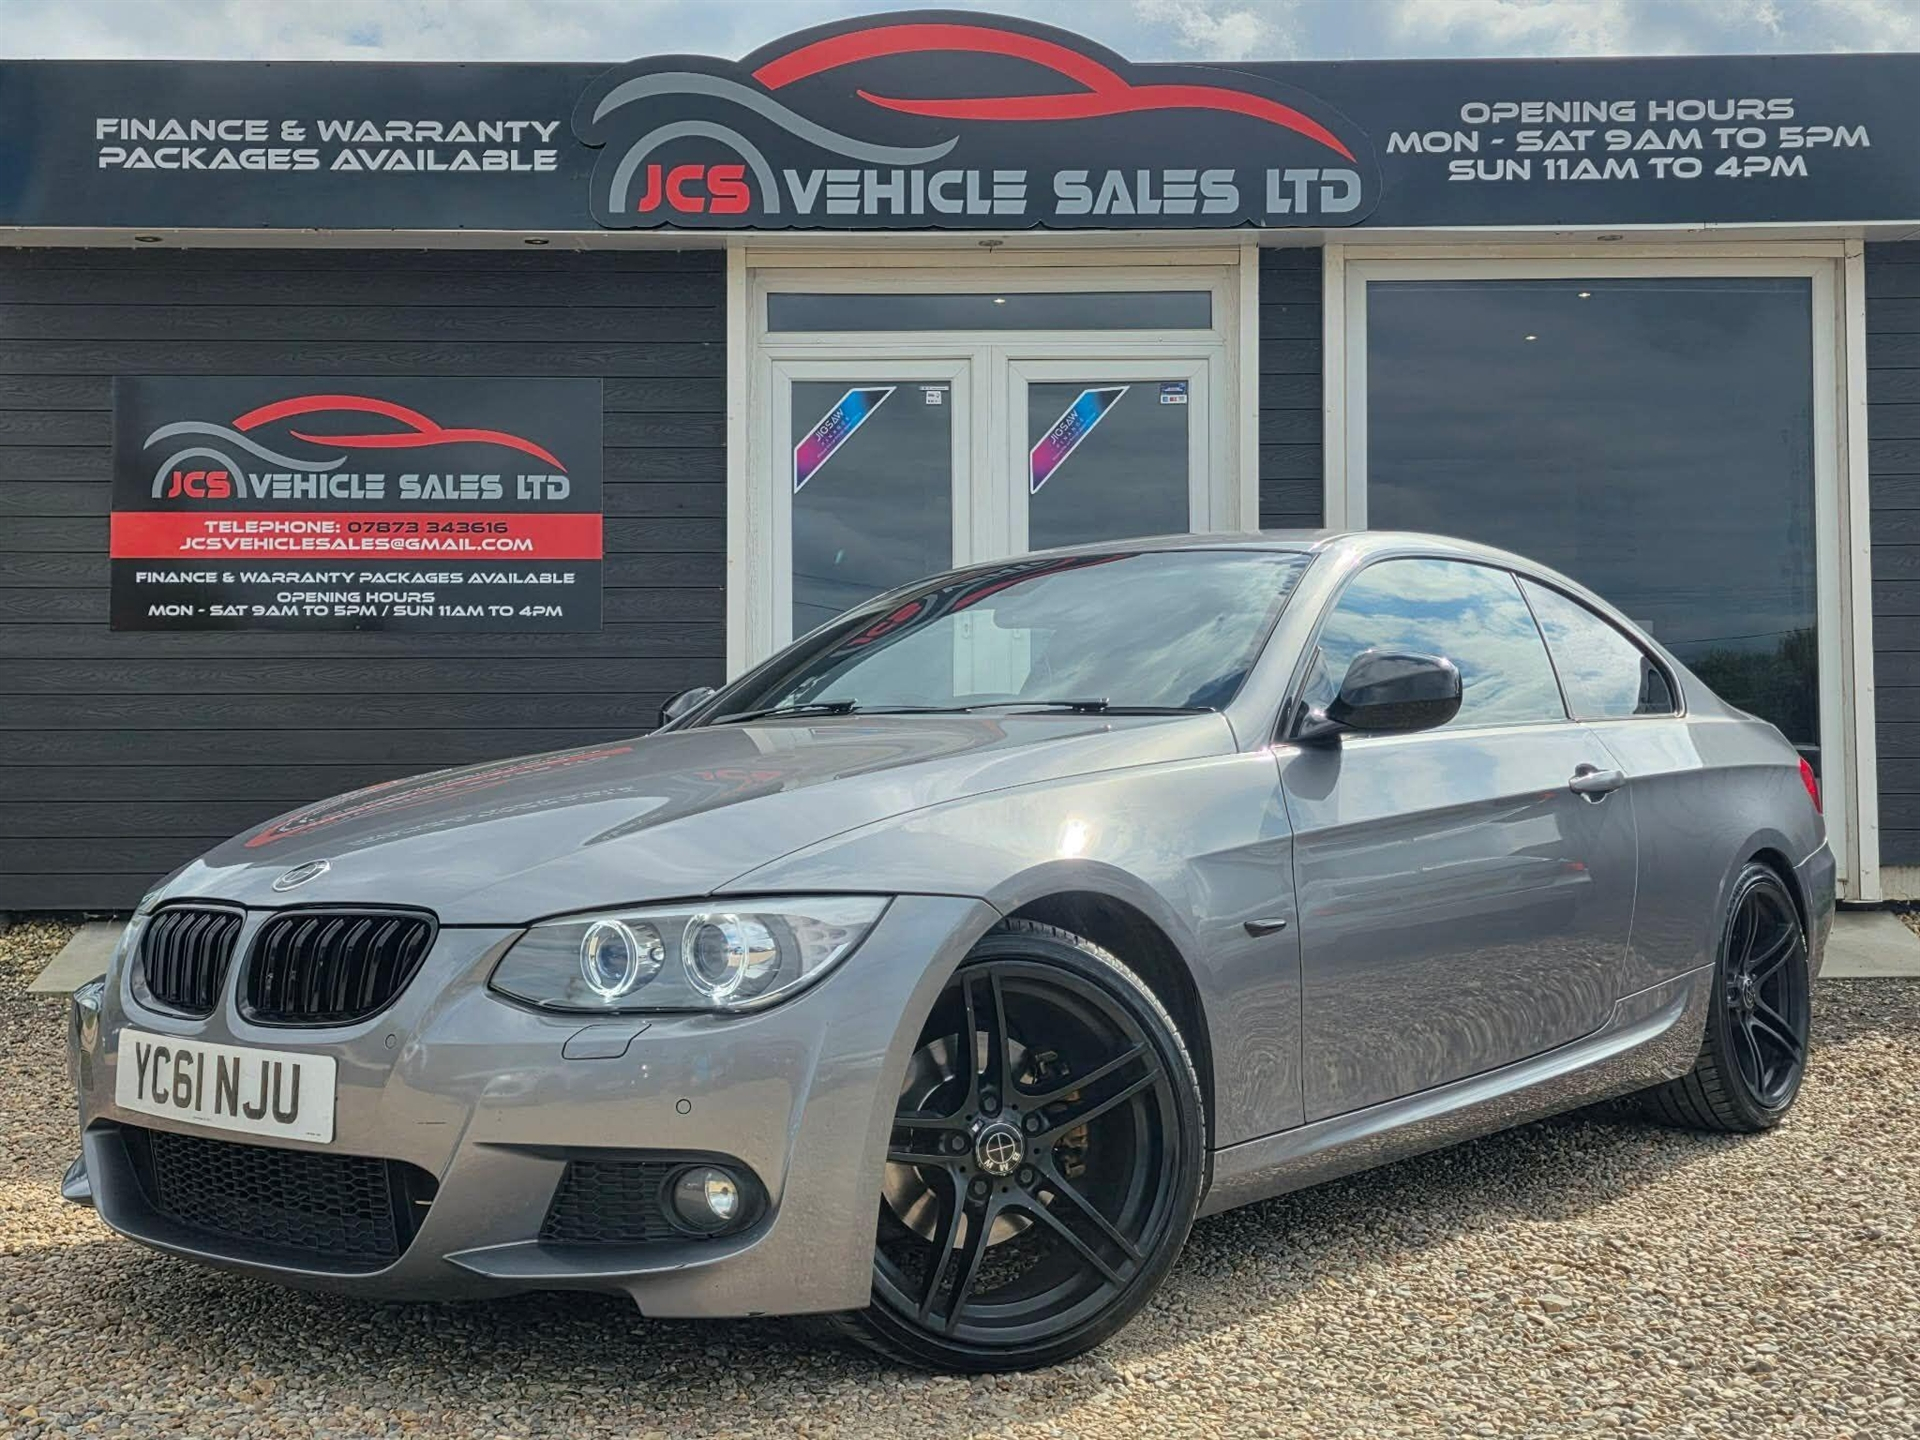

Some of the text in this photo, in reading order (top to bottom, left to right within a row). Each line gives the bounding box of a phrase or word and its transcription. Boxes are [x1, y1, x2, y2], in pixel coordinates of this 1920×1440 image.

[1461, 98, 1795, 124] OPENING HOURS
[96, 118, 561, 143] FINANCE & WARRANTY
[1387, 131, 1479, 153] MON
[1515, 130, 1596, 152] SAT
[1605, 128, 1704, 151] 9AM
[1711, 127, 1767, 149] TO
[1780, 125, 1871, 149] 5PM
[98, 147, 558, 172] PACKAGES AVAILABLE
[1448, 154, 1808, 181] SUN 11AM TO 4PM
[638, 165, 1363, 215] JCS VEHICLE SALES LTD
[815, 408, 844, 442] JIGSAW
[1049, 409, 1079, 444] JIGSAW
[167, 471, 571, 500] JCS VEHICLE SALES LTD
[204, 520, 508, 534] TELEPHONE: 07873 343616
[179, 537, 534, 551] JCSVEHICLESALES@GMAIL.COM
[135, 571, 576, 585] FINANCE & WARRANTY PACKAGES AVAILABLE
[147, 605, 194, 617] MON
[209, 605, 249, 616] SAT
[252, 605, 299, 617] 9AM
[303, 605, 329, 617] TO
[334, 605, 378, 617] 5PM
[382, 604, 389, 617] /
[394, 605, 434, 617] SUN
[438, 605, 484, 617] 11AM
[488, 605, 515, 617] TO
[518, 605, 563, 617] 4PM
[276, 591, 436, 604] OPENING HOURS
[135, 1041, 300, 1125] YC61 NJU
